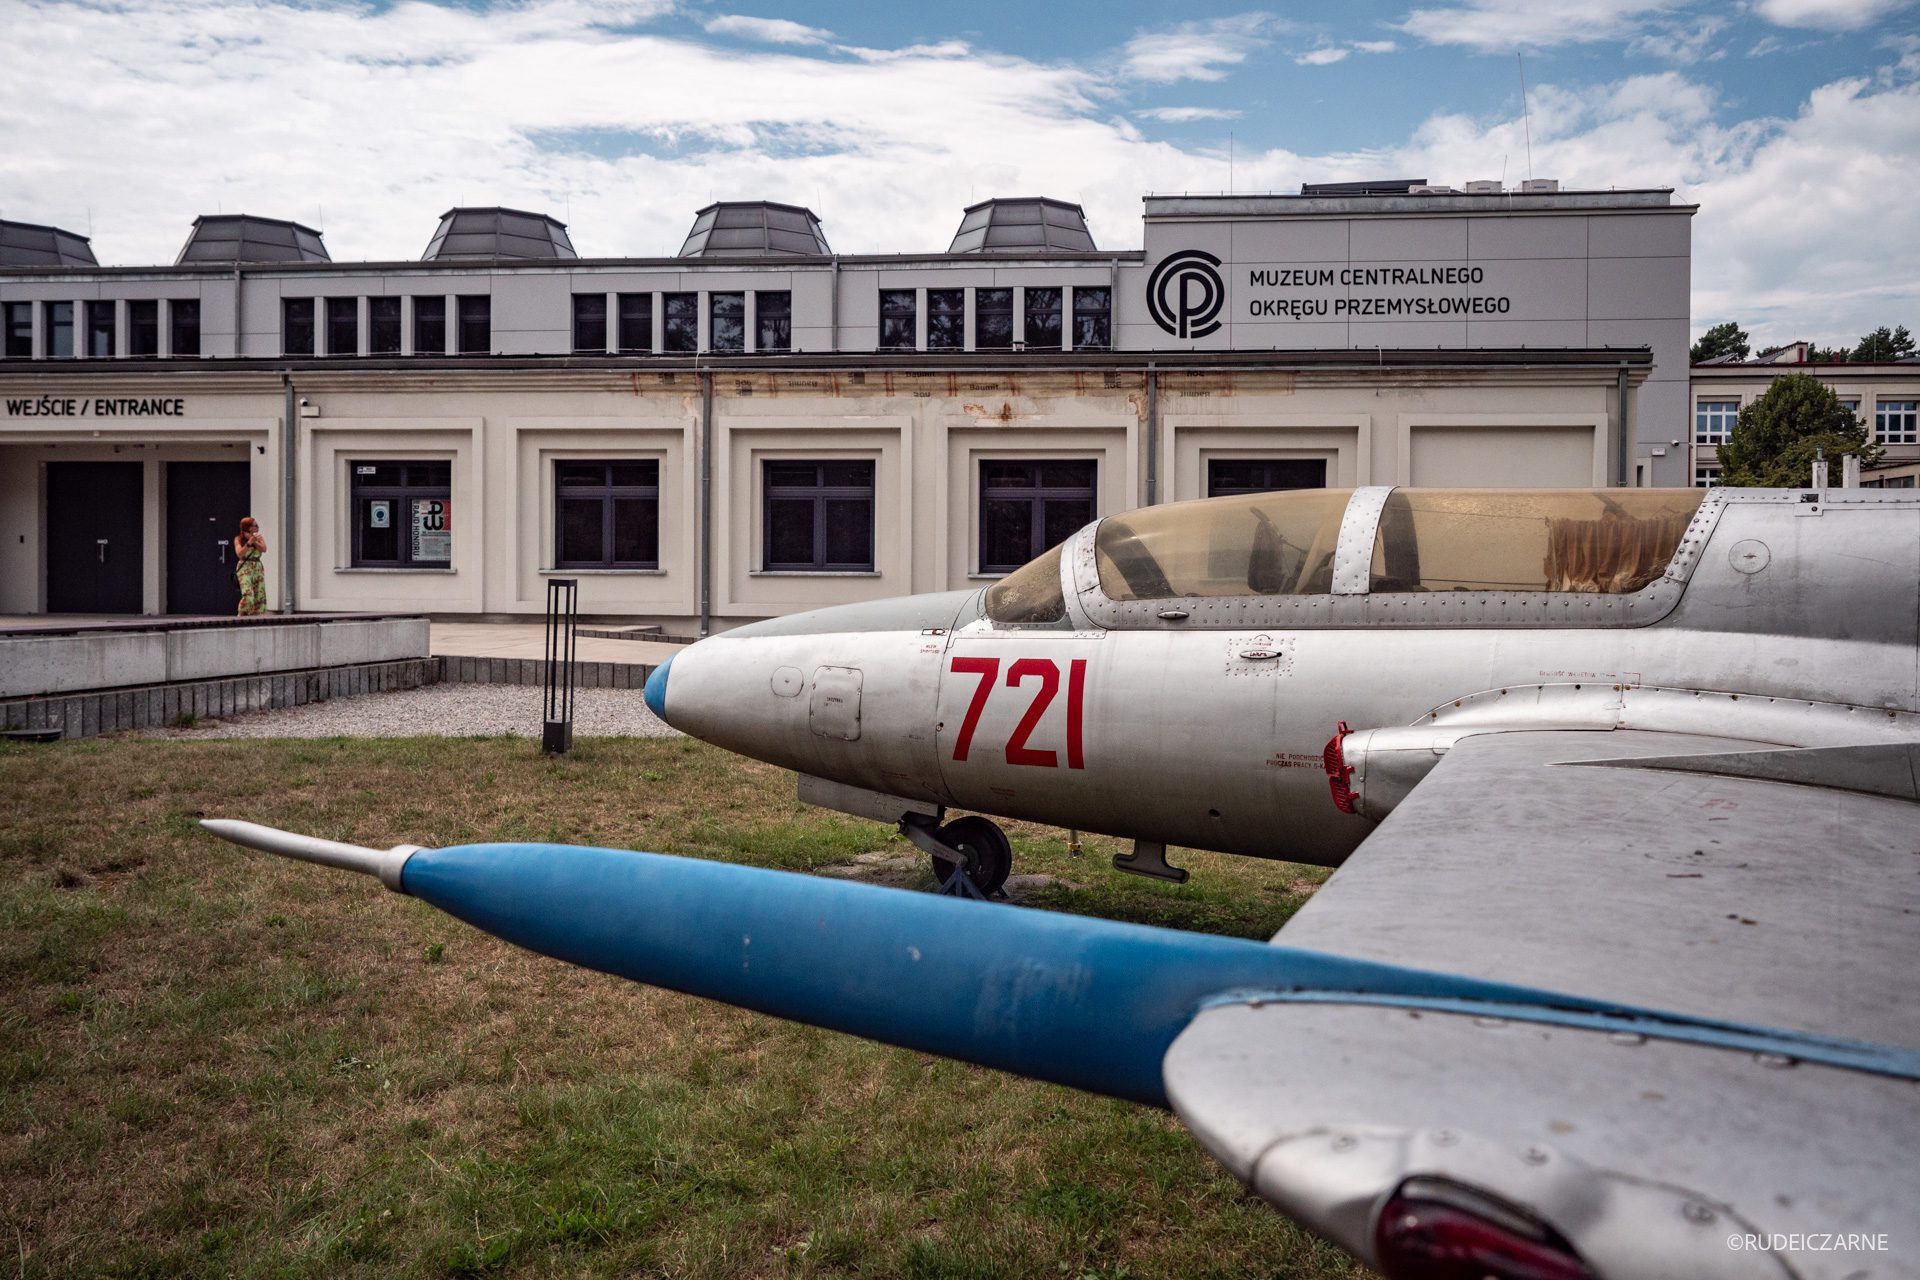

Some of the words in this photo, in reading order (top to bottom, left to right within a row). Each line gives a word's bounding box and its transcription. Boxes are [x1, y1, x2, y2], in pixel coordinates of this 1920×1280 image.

[1250, 269, 1334, 287] MUZEUM
[1340, 267, 1484, 286] CENTRALNEGO
[1250, 299, 1328, 320] OKRĘGU
[1335, 297, 1511, 316] PRZEMYSŁOWEGO
[7, 395, 76, 416] WEJŚCIE
[95, 399, 184, 416] ENTRANCE
[950, 657, 1088, 770] 721
